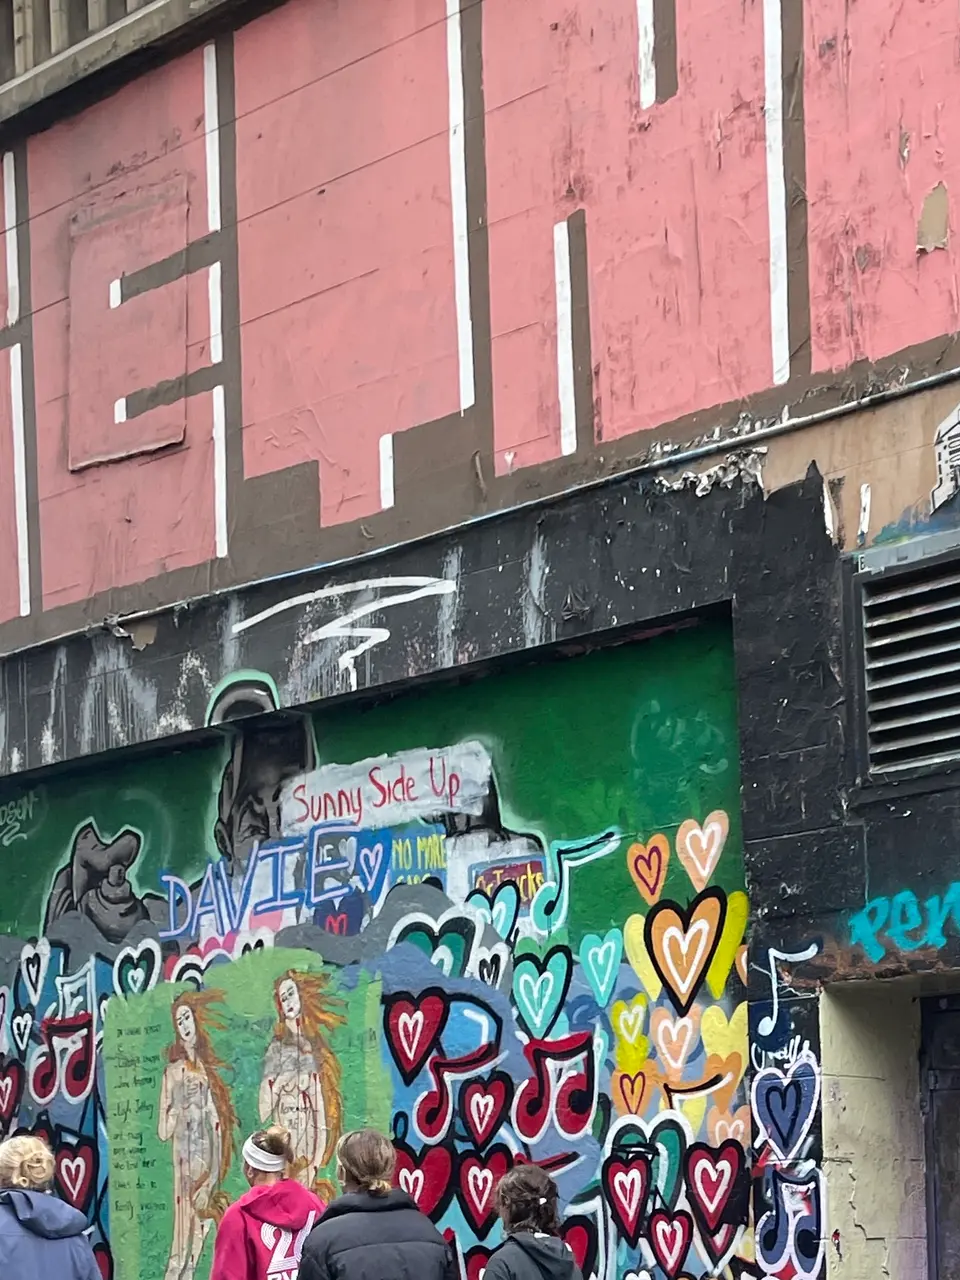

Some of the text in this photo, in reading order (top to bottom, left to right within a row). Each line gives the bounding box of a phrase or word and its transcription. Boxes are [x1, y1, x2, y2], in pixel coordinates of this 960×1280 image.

[292, 757, 461, 826] Sunny Side Up
[158, 822, 362, 940] DAVIE
[391, 838, 413, 872] NO
